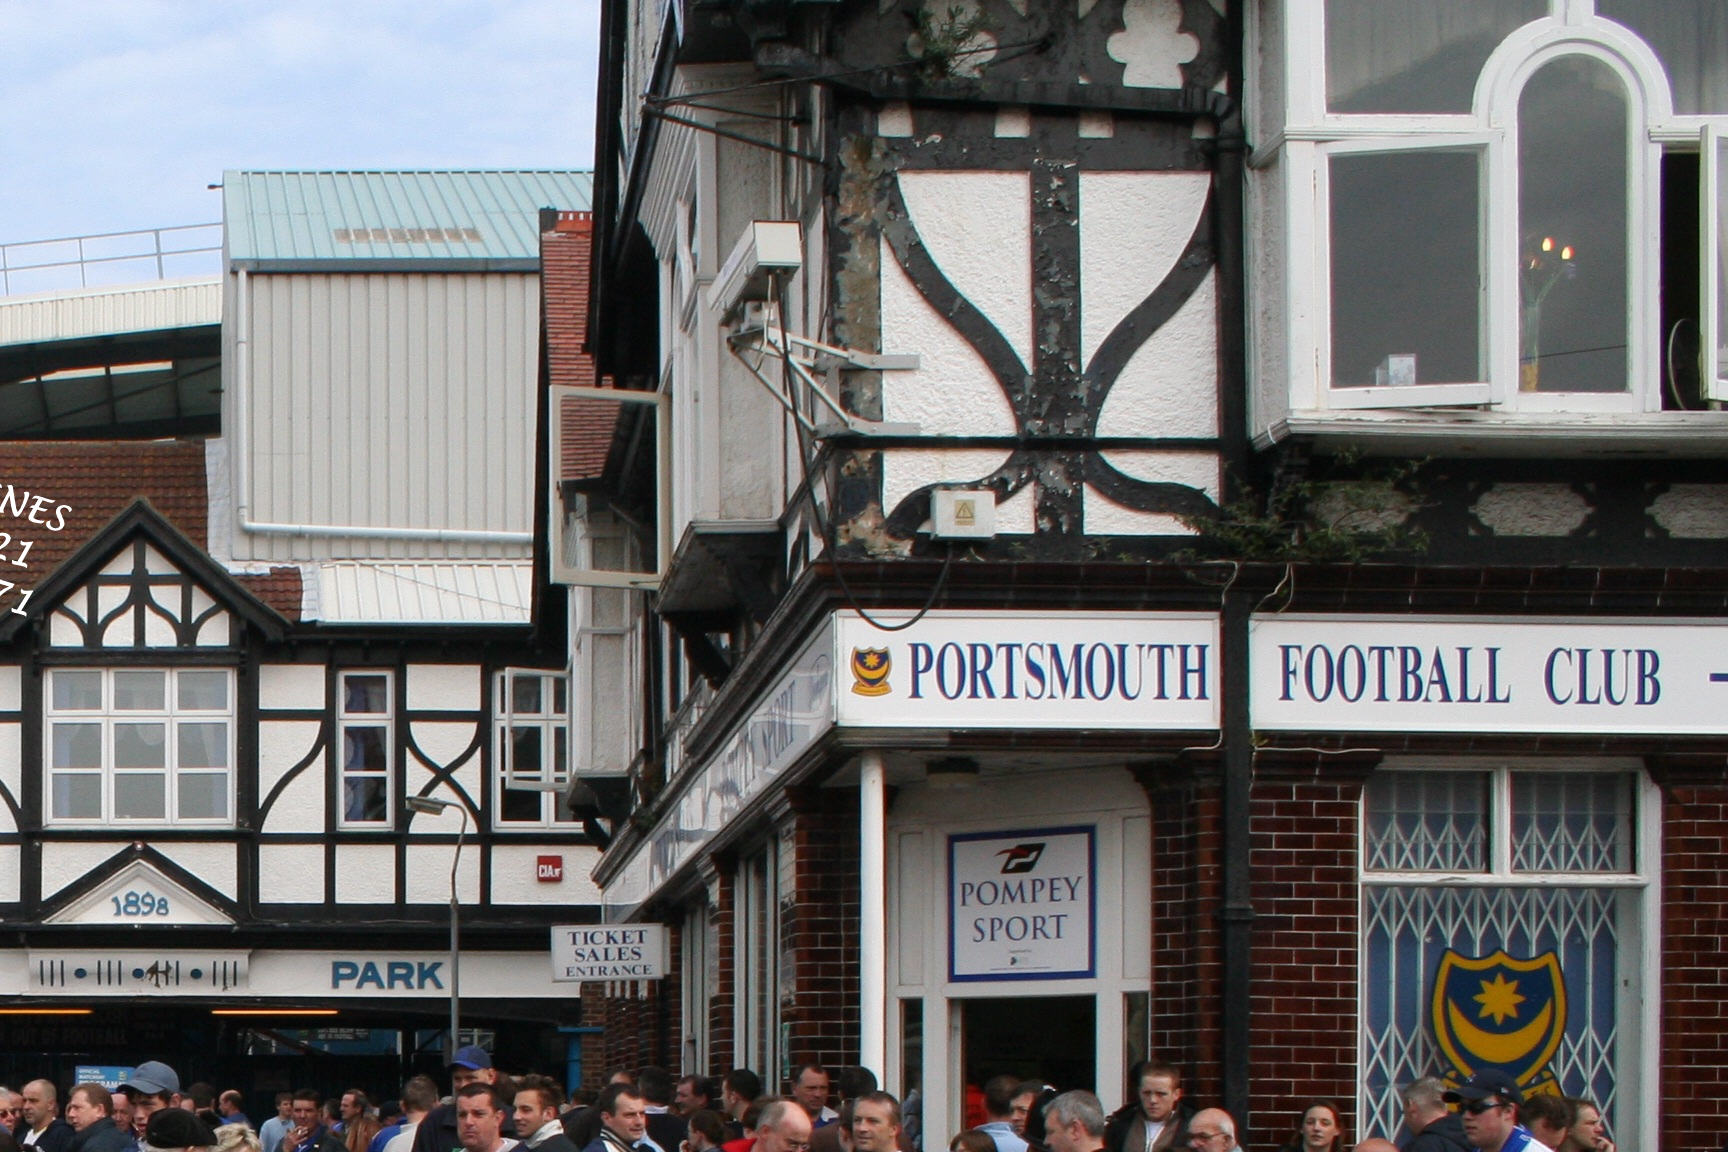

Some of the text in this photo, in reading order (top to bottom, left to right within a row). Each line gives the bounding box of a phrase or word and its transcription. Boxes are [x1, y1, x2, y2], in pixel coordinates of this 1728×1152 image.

[908, 641, 1661, 706] PORTSMOUTH FOOTBALL CLUB
[111, 890, 169, 916] 1898
[960, 876, 1083, 906] POMPEY
[567, 929, 648, 946] TICKET
[972, 914, 1068, 943] SPORT
[574, 946, 642, 962] SALES
[331, 961, 444, 990] PARK
[565, 964, 653, 977] ENTRANCE
